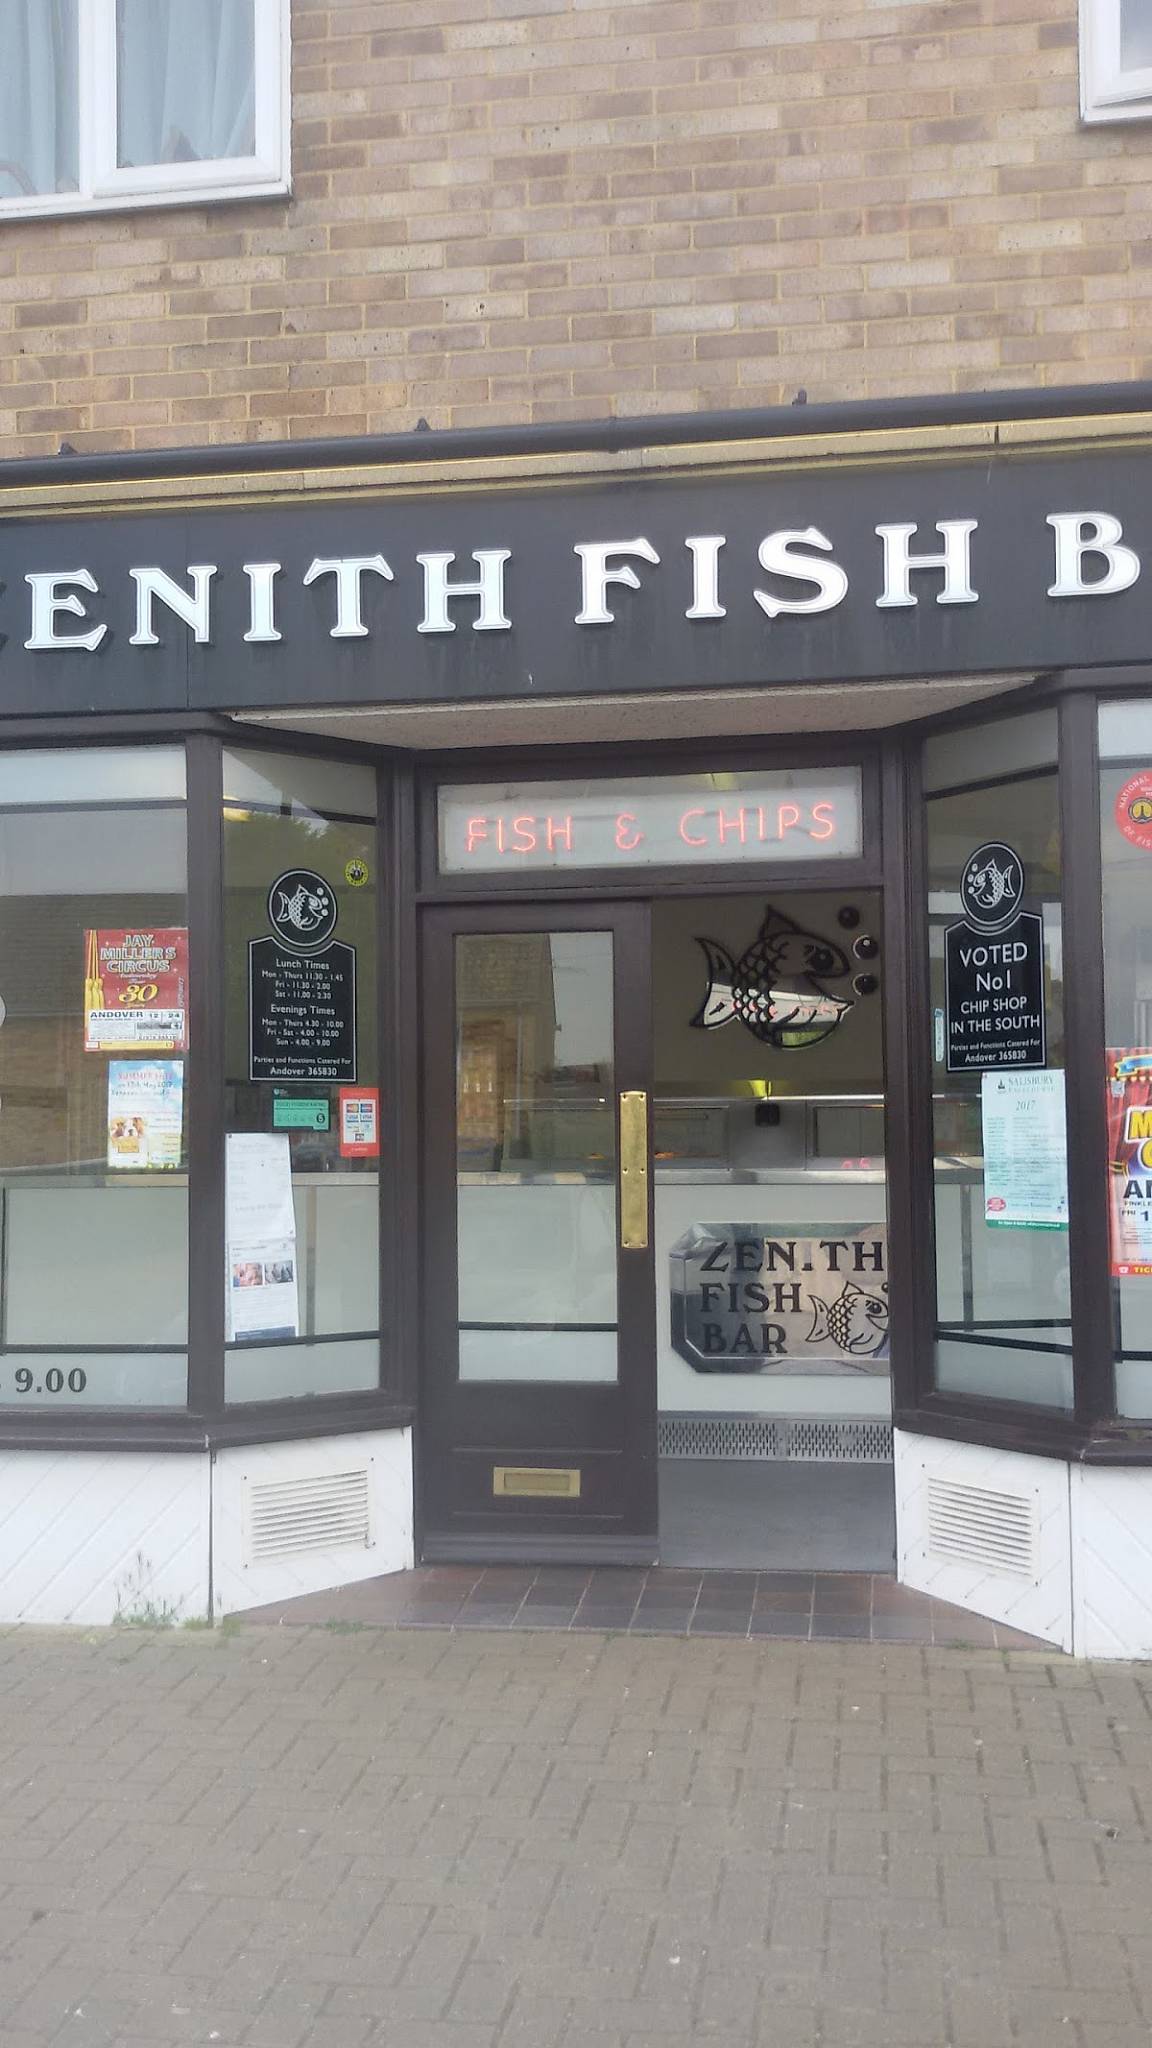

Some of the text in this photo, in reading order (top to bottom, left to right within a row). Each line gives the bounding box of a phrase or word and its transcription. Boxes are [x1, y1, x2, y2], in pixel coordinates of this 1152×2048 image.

[574, 518, 978, 624] FISH
[465, 803, 835, 853] FISH & CHIPS
[123, 934, 154, 948] JAY
[960, 942, 1028, 968] VOTED
[107, 959, 170, 973] CIRCUS
[276, 958, 330, 970] Lunch Times
[262, 970, 277, 978] Mon
[284, 971, 303, 980] Thurs
[305, 972, 323, 981] 11.30
[330, 974, 344, 982] 1.45
[275, 980, 285, 988] Fri
[292, 981, 310, 989] 11.30
[317, 982, 331, 990] 2.00
[118, 983, 158, 1003] 30
[275, 990, 286, 998] Sat
[293, 991, 311, 999] 11.00
[270, 1004, 335, 1016] Evenings Times
[961, 996, 1027, 1014] CHIP SHOP
[262, 1018, 277, 1026] Mon
[284, 1019, 303, 1027] Thurs
[305, 1020, 319, 1028] 4.30
[326, 1020, 344, 1028] 10.00
[951, 1014, 1040, 1034] IN THE SOUTH
[267, 1028, 277, 1036] Fri
[283, 1028, 294, 1037] Sat
[300, 1029, 315, 1037] 4.00
[322, 1030, 340, 1038] 10.00
[276, 1038, 289, 1046] Sun
[316, 1039, 331, 1047] 9.00
[276, 1056, 287, 1064] and
[965, 1050, 1027, 1063] Andover 365830
[270, 1066, 337, 1076] Andover 365830
[700, 1282, 802, 1314] FISH
[702, 1322, 788, 1354] BAR
[15, 1367, 87, 1393] 9.00
